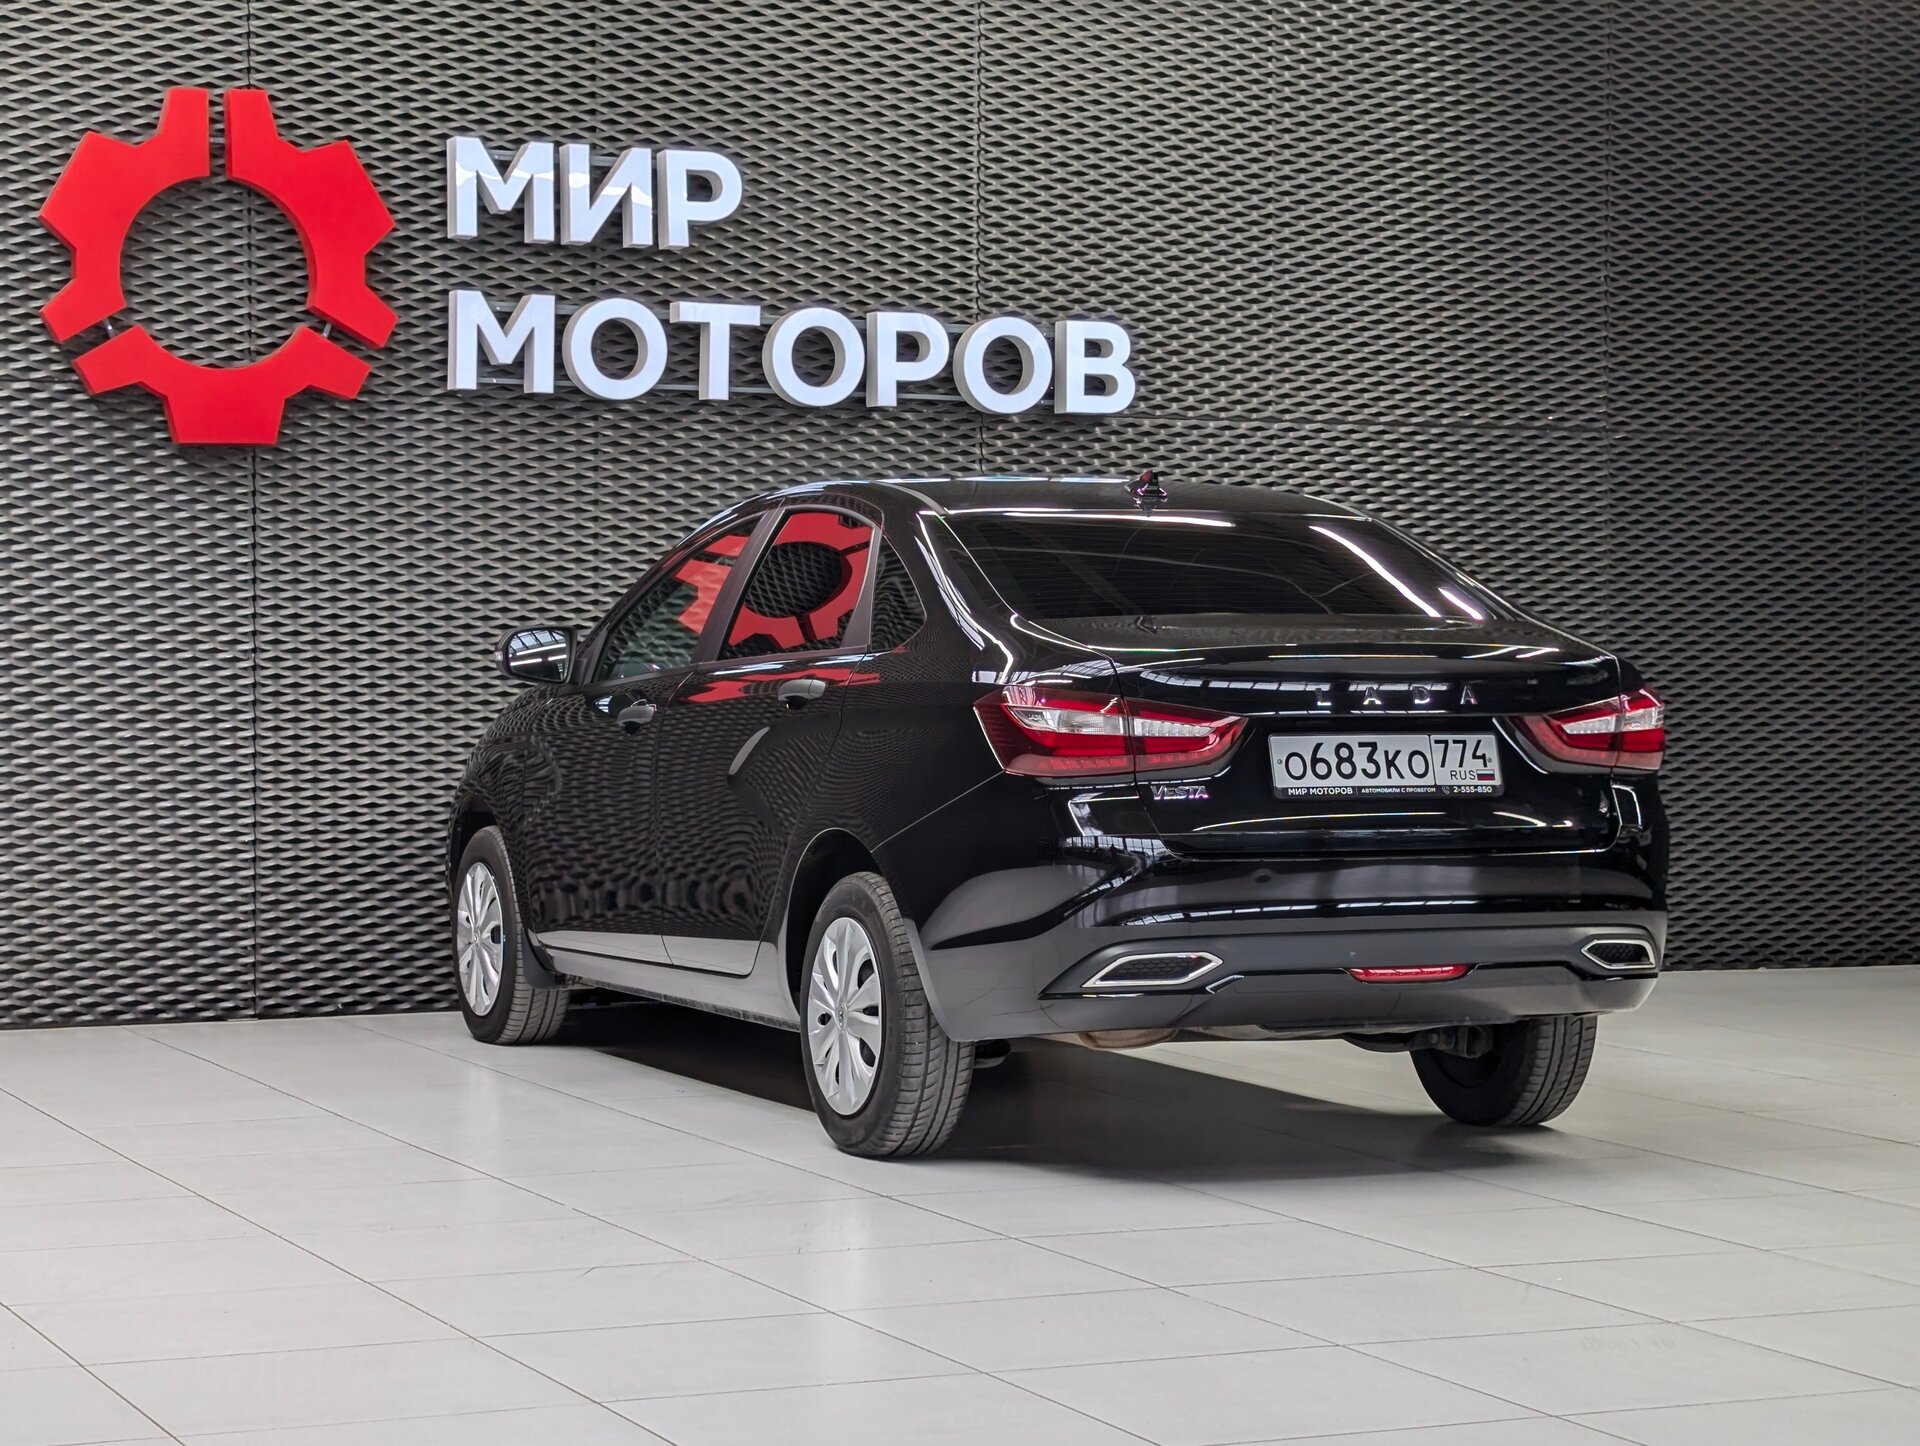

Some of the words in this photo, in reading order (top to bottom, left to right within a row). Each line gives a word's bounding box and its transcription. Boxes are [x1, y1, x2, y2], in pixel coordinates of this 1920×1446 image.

[447, 136, 743, 251] МИР
[447, 290, 1137, 415] МОТОРОВ
[1315, 685, 1478, 706] LADA
[1284, 742, 1430, 781] О683КО
[1433, 739, 1488, 769] 774
[1449, 769, 1477, 781] RUS
[1150, 785, 1209, 800] VESTA
[1288, 787, 1308, 796] МИР
[1309, 787, 1353, 795] МОТОРОВ
